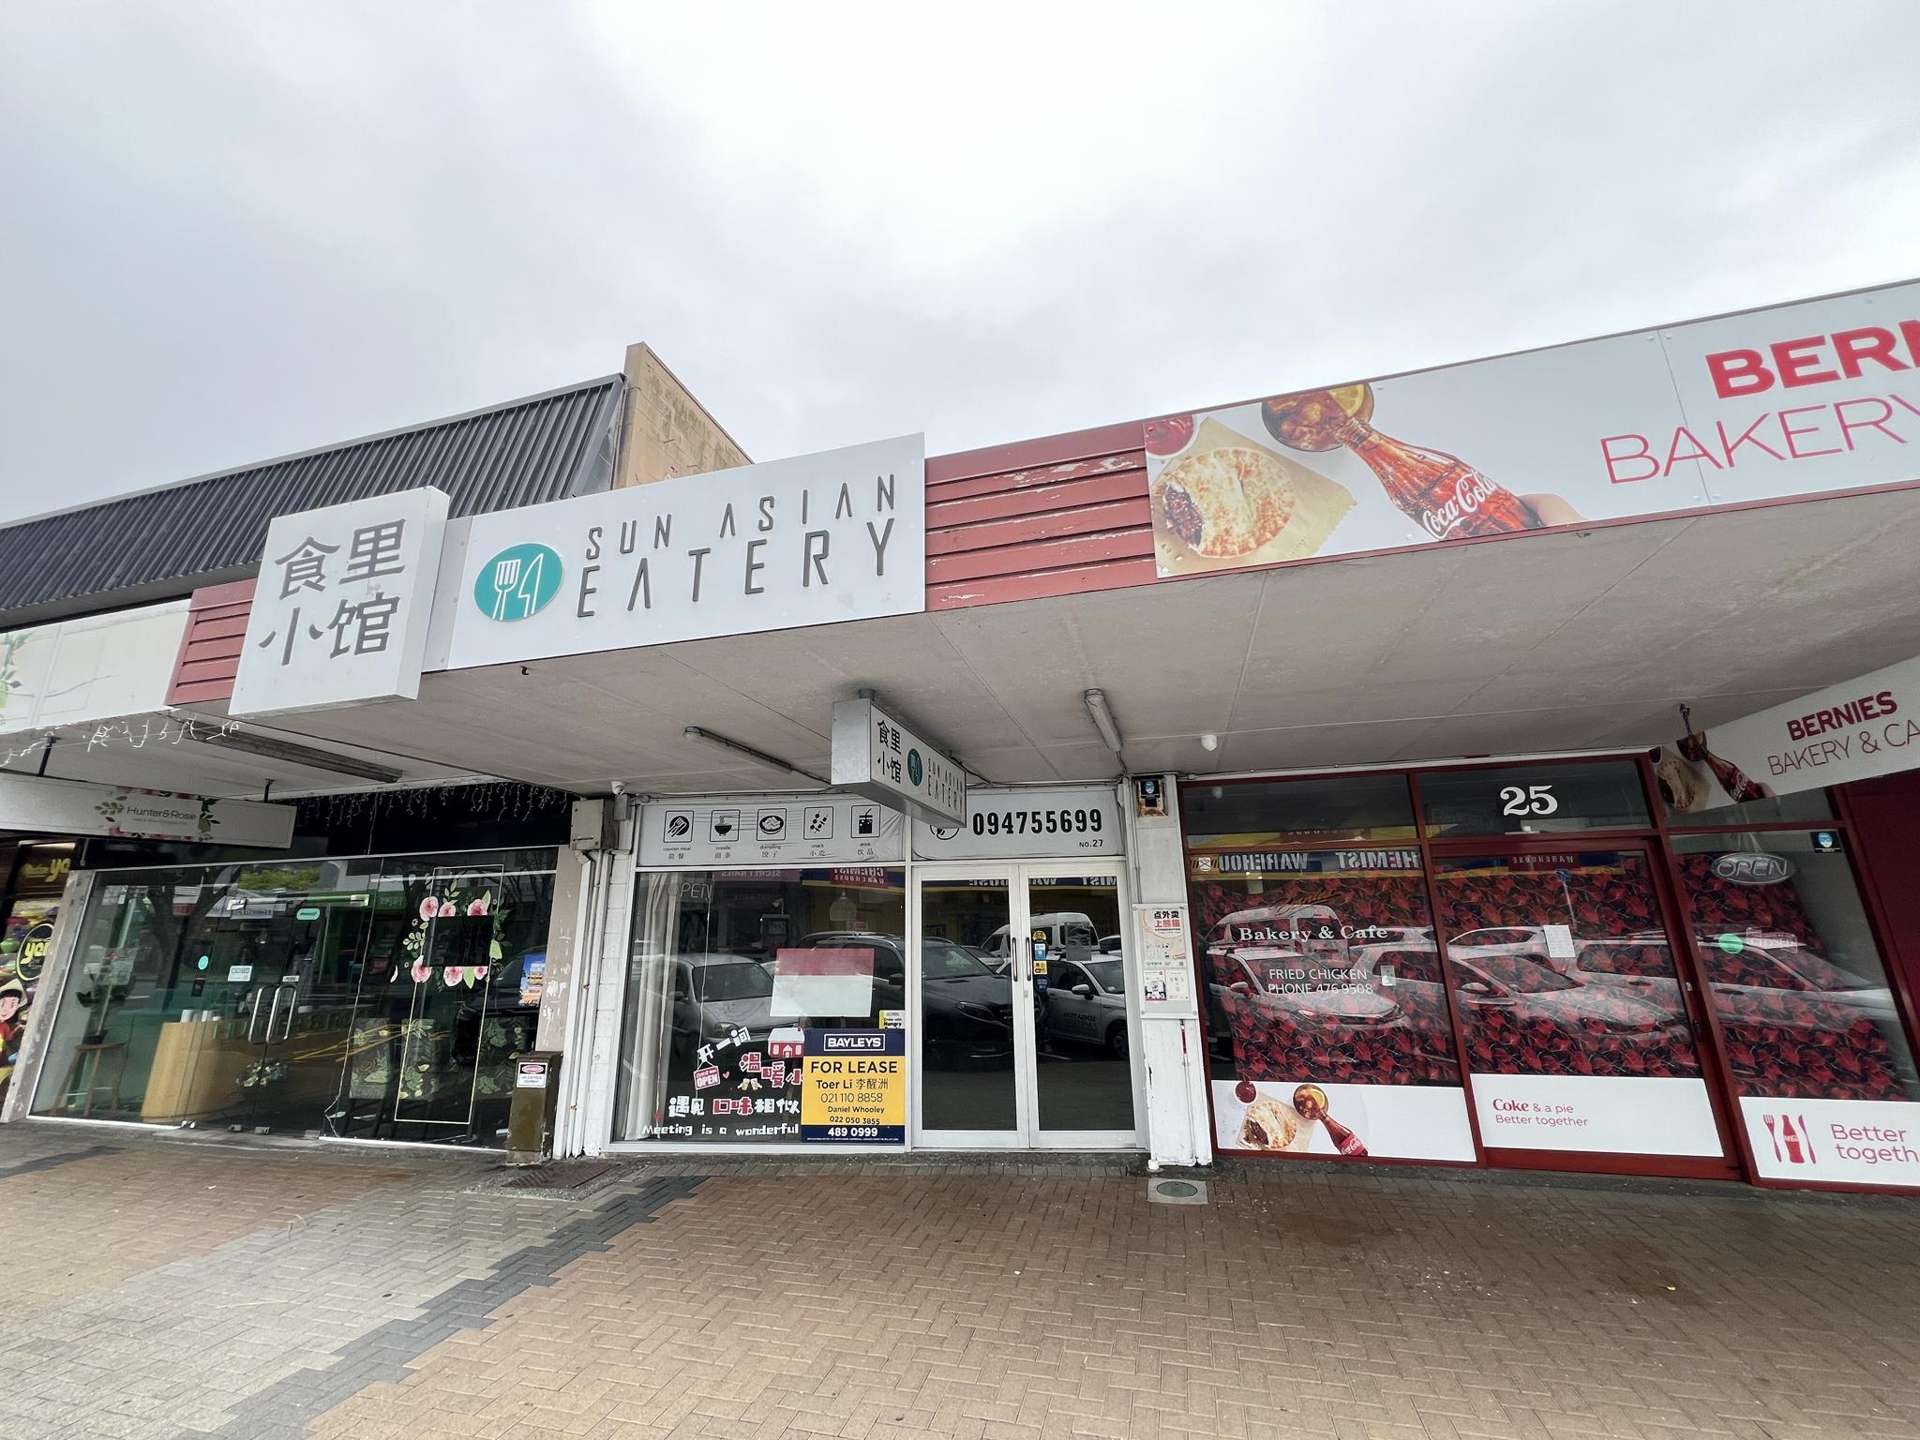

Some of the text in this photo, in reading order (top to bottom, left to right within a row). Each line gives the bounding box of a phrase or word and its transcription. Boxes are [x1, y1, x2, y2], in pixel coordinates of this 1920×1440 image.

[585, 473, 896, 561] SUN ASIAN
[275, 518, 406, 600] 食里
[577, 517, 896, 618] EATERY
[259, 592, 400, 666] 小馆
[1787, 691, 1897, 741] BERNIES
[1767, 736, 1850, 776] BAKERY
[1859, 730, 1882, 754] &
[1500, 785, 1558, 816] 25
[972, 808, 1102, 836] 094755699
[1716, 857, 1788, 877] OPEN
[1239, 924, 1389, 942] Bakery & Cafe
[1269, 968, 1367, 980] FRIED CHICKEN
[1268, 983, 1311, 995] PHONE
[828, 1037, 881, 1048] BAYLEYS
[811, 1061, 898, 1073] FOR LEASE
[816, 1080, 839, 1089] Toer
[843, 1080, 852, 1089] Li
[820, 1093, 883, 1103] 021 110 8858
[1492, 1098, 1574, 1114] Coke & a pie
[828, 1105, 885, 1114] Daniel Whooley
[829, 1115, 881, 1125] 022 050 3855
[1496, 1114, 1588, 1127] Better together
[642, 1123, 799, 1136] Meeting is a wonderful
[827, 1127, 878, 1137] 489 0999
[1830, 1123, 1907, 1142] Better
